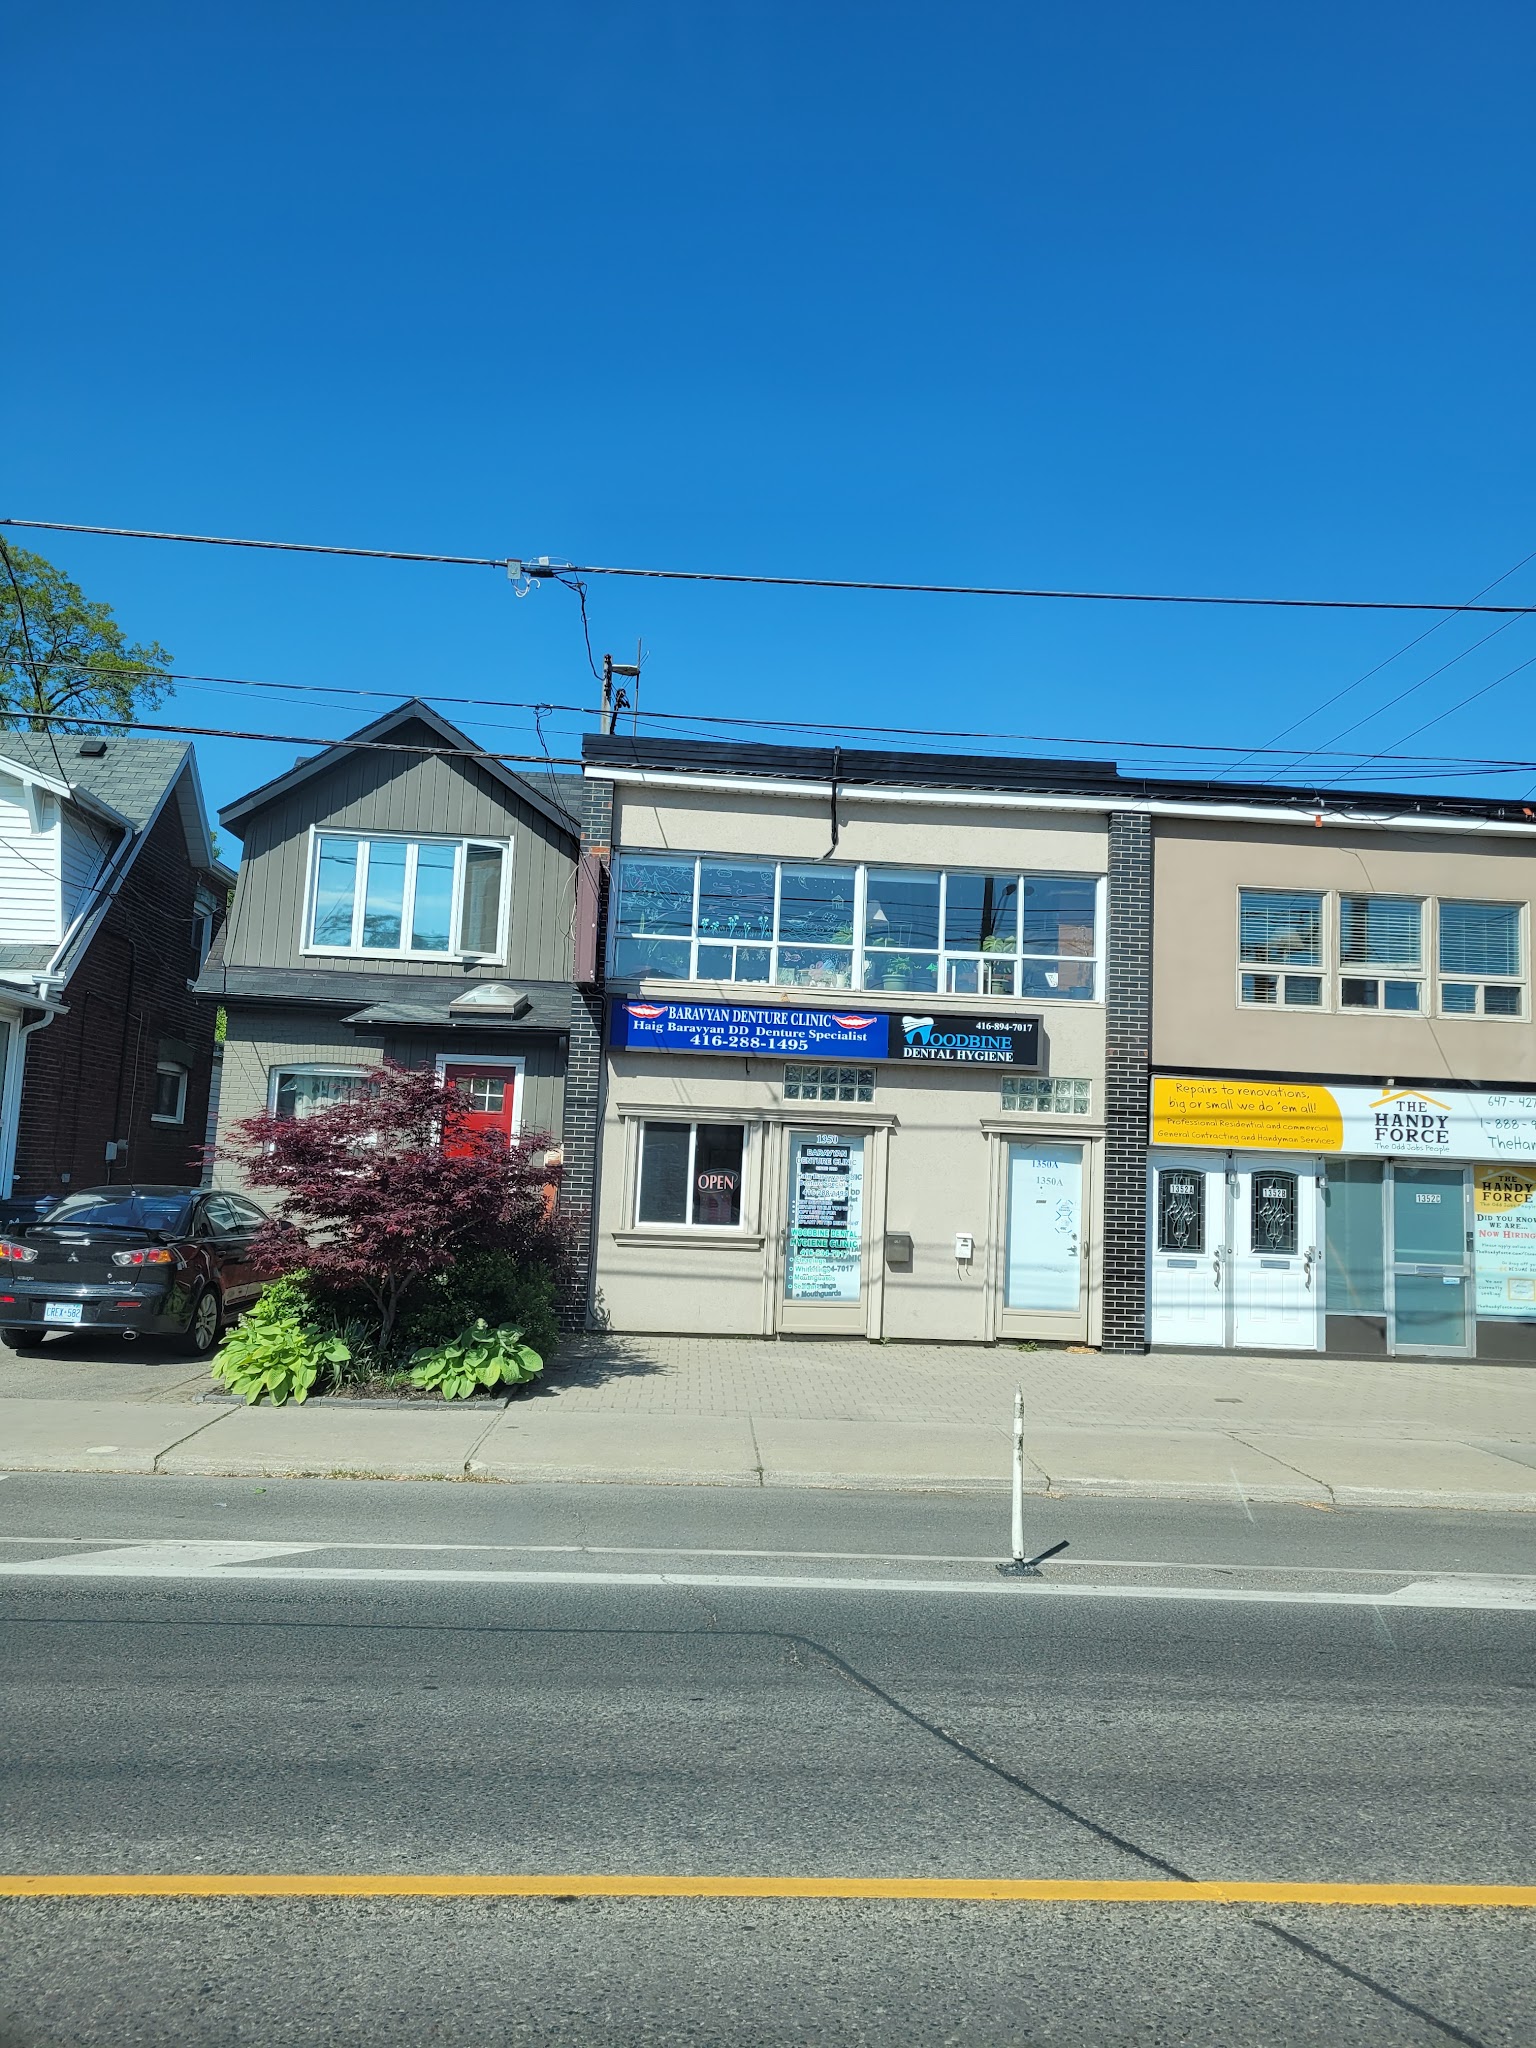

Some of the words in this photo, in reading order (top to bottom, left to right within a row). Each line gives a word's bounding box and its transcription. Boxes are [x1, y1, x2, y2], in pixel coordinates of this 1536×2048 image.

[668, 1006, 729, 1024] BARAVYAN
[732, 1010, 789, 1026] DENTURE
[790, 1012, 832, 1028] CLINIC
[633, 1020, 664, 1033] Haig
[667, 1022, 725, 1036] Baravyan
[728, 1026, 749, 1035] DD
[755, 1027, 805, 1038] Denture
[808, 1029, 868, 1042] Specialist
[975, 1021, 1033, 1033] 416-894-7017
[690, 1034, 809, 1051] 416-288-1495
[903, 1047, 955, 1060] DENTAL
[957, 1050, 1014, 1063] HYGIENE
[1175, 1083, 1218, 1098] Repairs
[1221, 1084, 1234, 1096] to
[1237, 1088, 1310, 1100] renovations,
[1169, 1097, 1186, 1114] big
[1189, 1102, 1203, 1110] or
[1205, 1099, 1234, 1111] small
[1237, 1103, 1255, 1111] we
[1258, 1099, 1273, 1112] do
[1300, 1102, 1317, 1114] all!
[1396, 1100, 1428, 1112] THE
[1166, 1117, 1218, 1127] Professional
[1219, 1120, 1265, 1130] Residential
[1266, 1121, 1281, 1130] and
[1282, 1123, 1329, 1133] commercial
[1374, 1112, 1449, 1129] HANDY
[816, 1134, 839, 1145] 1350
[1157, 1129, 1190, 1139] General
[1191, 1131, 1240, 1144] Contracting
[1241, 1134, 1256, 1142] and
[1257, 1133, 1299, 1146] Handyman
[1300, 1137, 1336, 1146] Services
[1374, 1127, 1450, 1144] FORCE
[1374, 1142, 1390, 1150] The
[1391, 1143, 1406, 1151] Odd
[1407, 1143, 1424, 1152] Jobs
[1425, 1144, 1450, 1154] People
[833, 1158, 857, 1166] CLINIC
[1032, 1160, 1059, 1169] 1350A
[698, 1174, 734, 1190] OPEN
[1036, 1176, 1064, 1187] 1350A
[1498, 1175, 1518, 1183] THE
[1171, 1185, 1194, 1194] 1352A
[1482, 1182, 1533, 1193] HANDY
[1482, 1191, 1534, 1204] FORCE
[791, 1228, 829, 1238] WOODBINE
[830, 1229, 858, 1239] DENTAL
[790, 1238, 827, 1248] HYGIENE
[829, 1239, 858, 1249] CLINIC
